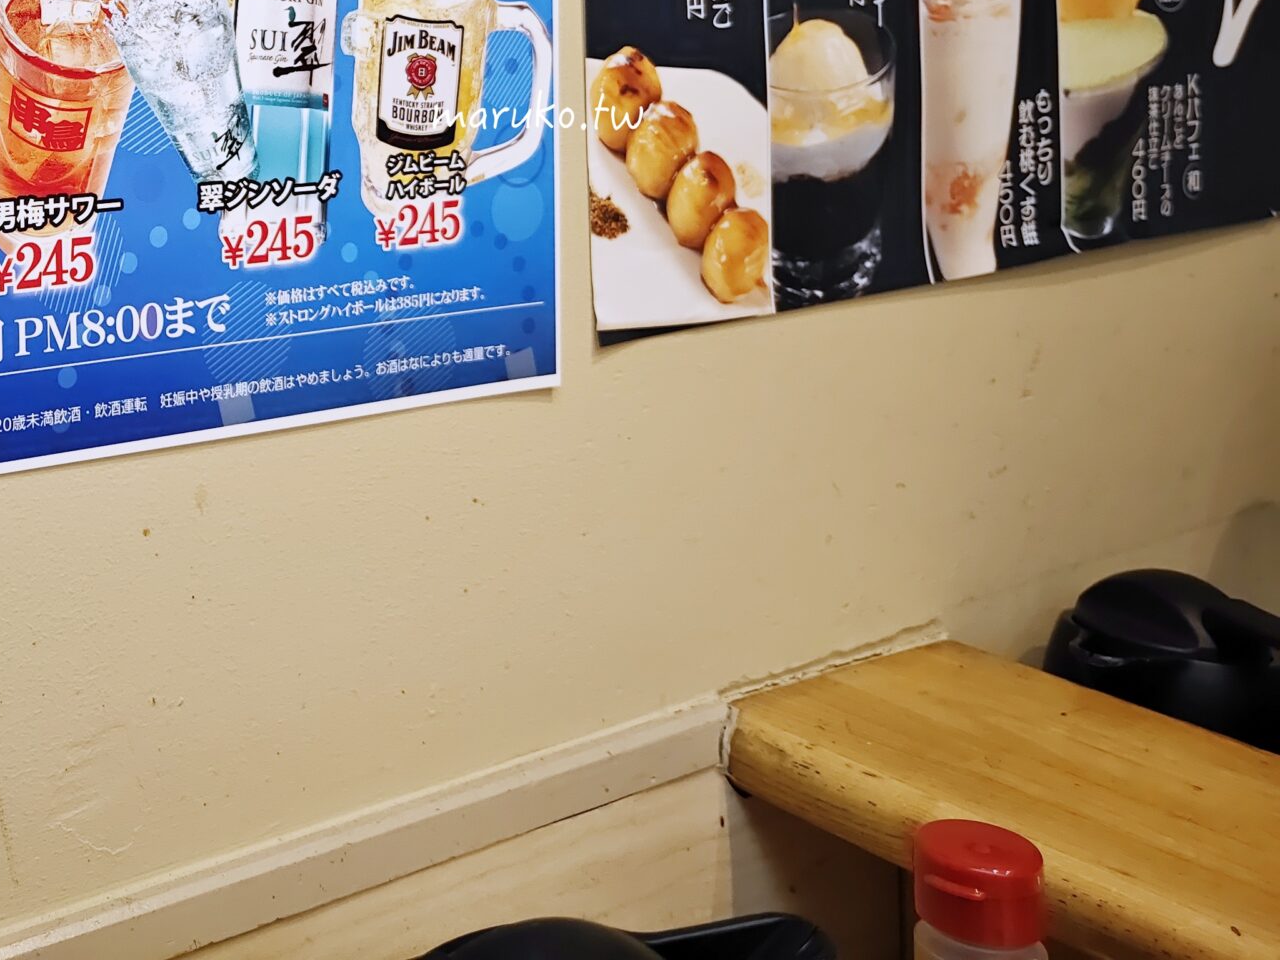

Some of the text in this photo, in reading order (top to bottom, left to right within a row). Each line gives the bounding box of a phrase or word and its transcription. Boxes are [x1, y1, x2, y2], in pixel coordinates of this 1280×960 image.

[249, 28, 288, 52] SUI
[387, 30, 456, 61] JIM BEAM
[386, 151, 466, 175] ジムビーム
[198, 171, 341, 212] 翠ジンソーダ
[386, 175, 466, 199] ハイボール
[378, 200, 460, 247] ¥245
[223, 216, 315, 267] ¥245
